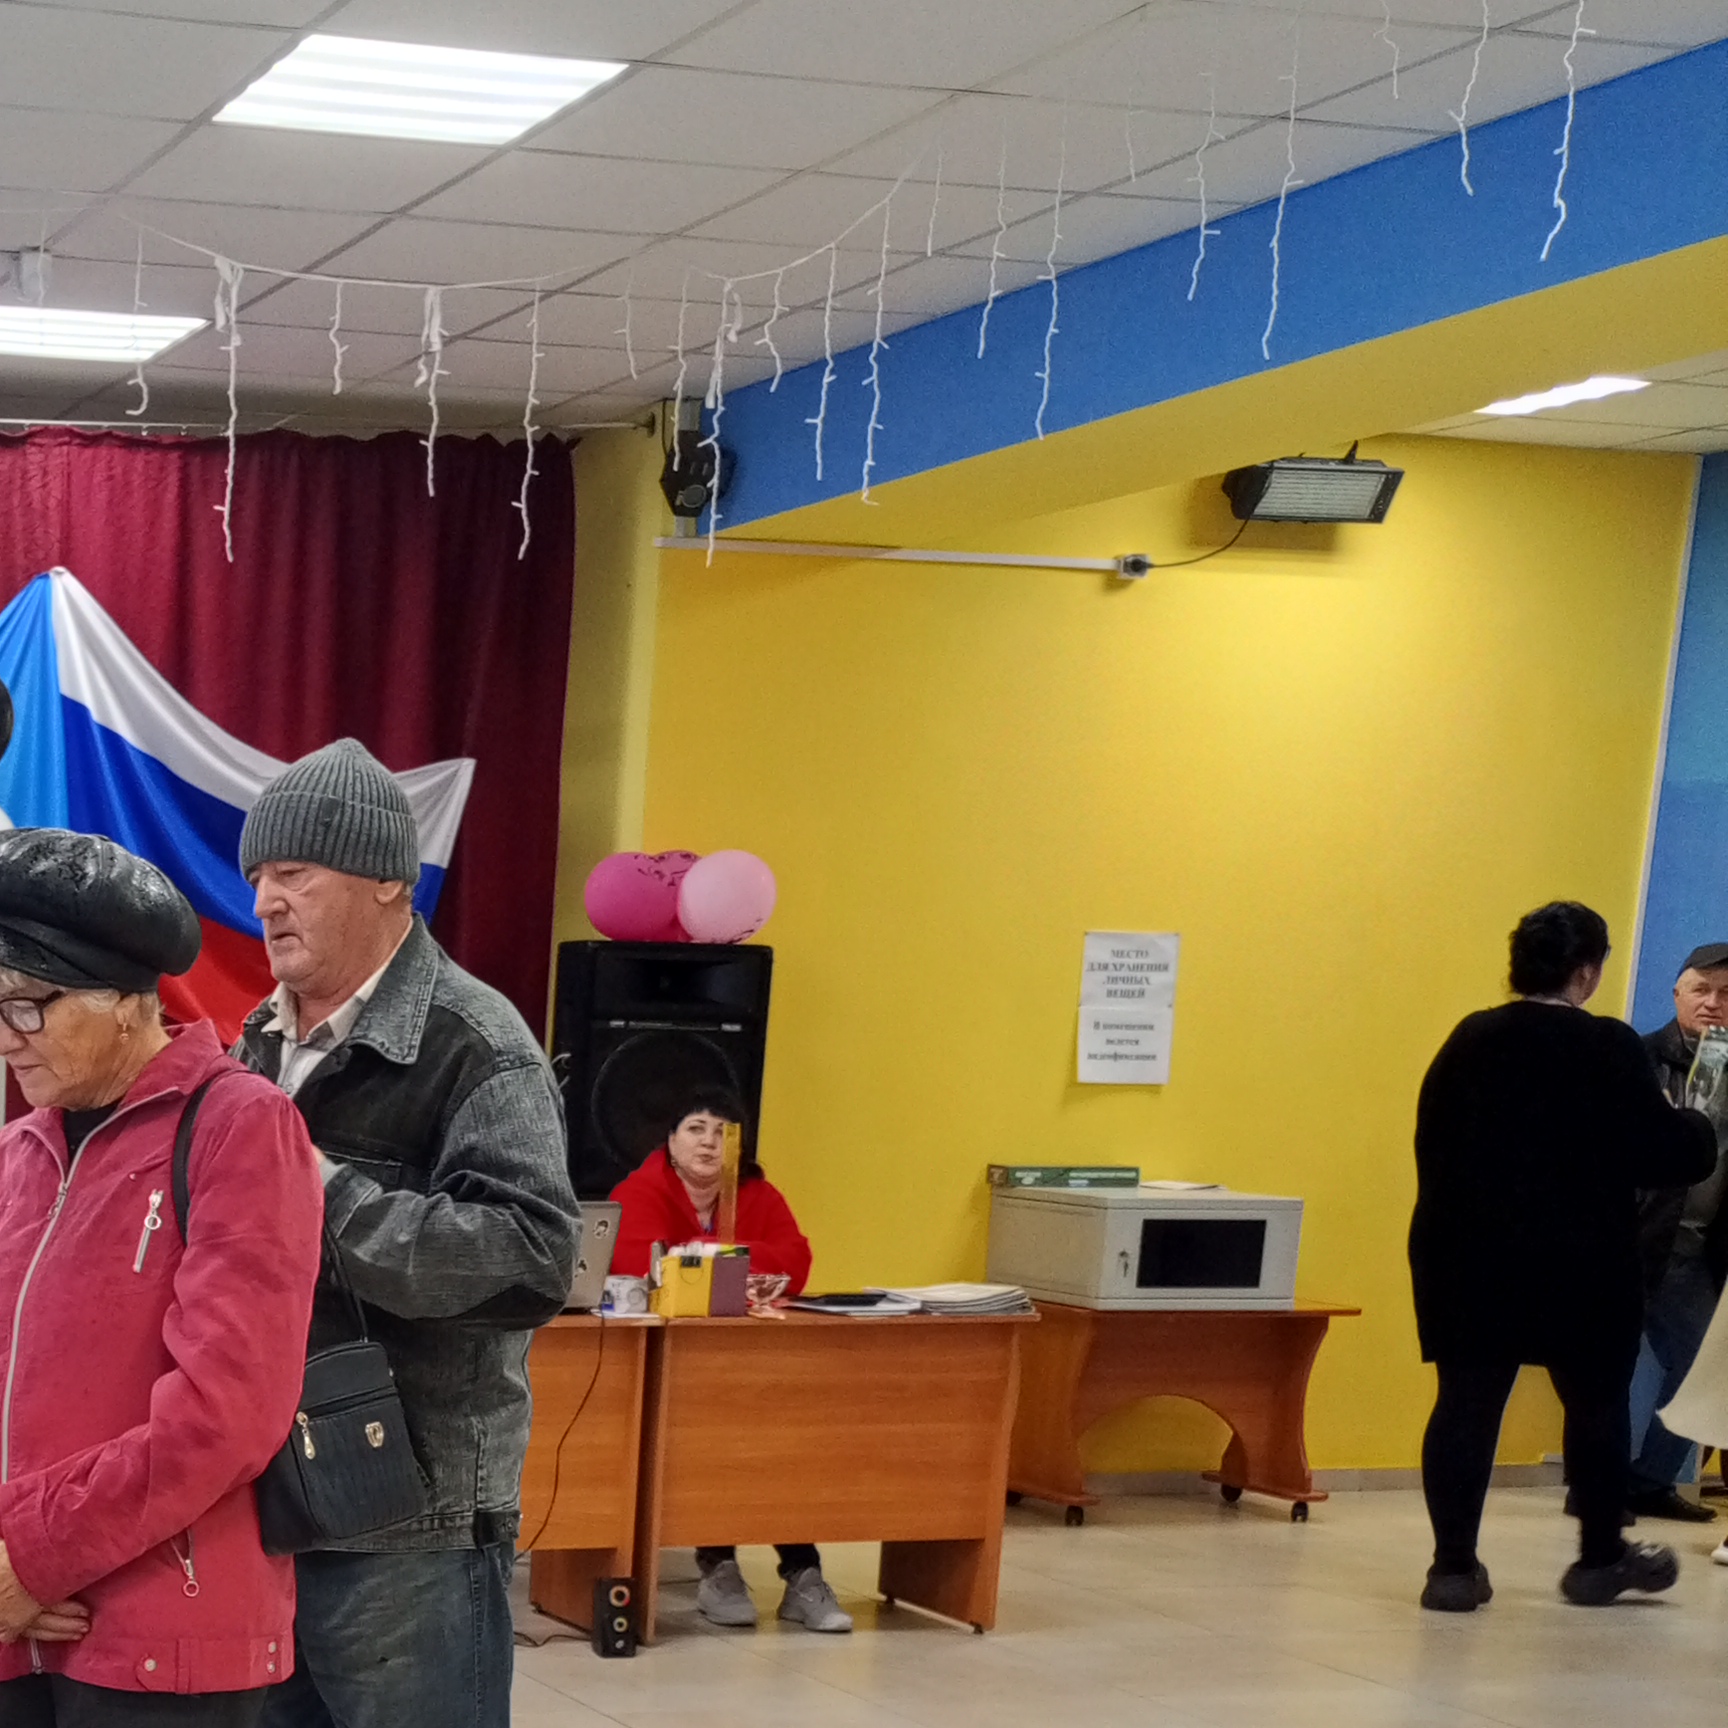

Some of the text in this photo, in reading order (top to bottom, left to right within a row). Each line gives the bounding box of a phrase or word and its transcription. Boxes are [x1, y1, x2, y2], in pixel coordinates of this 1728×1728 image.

[1111, 949, 1149, 959] МЕСТО
[1086, 962, 1169, 973] ДЛЯ ХРАНЕНИЯ
[1103, 975, 1151, 986] ЛИЧНЫХ
[1106, 987, 1146, 999] ВЕЩЕЙ
